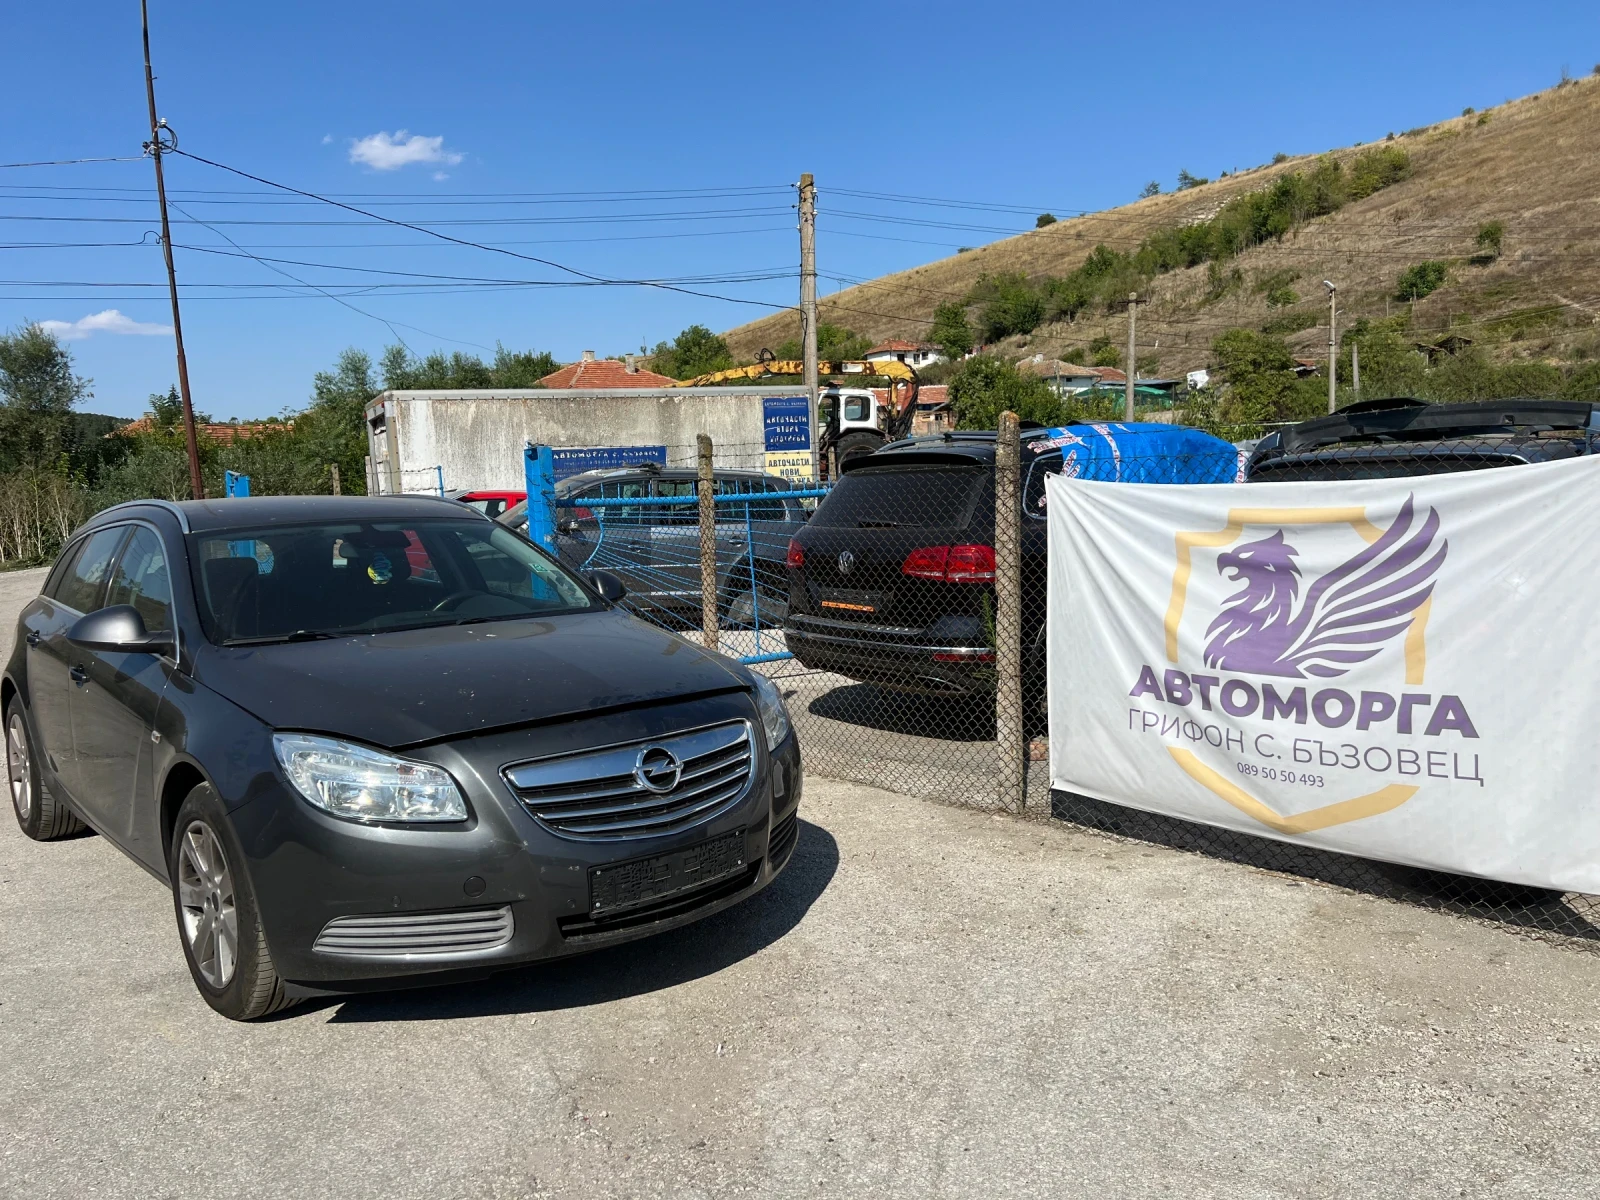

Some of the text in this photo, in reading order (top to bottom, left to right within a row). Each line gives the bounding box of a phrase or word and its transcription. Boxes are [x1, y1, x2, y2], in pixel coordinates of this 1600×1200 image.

[768, 458, 810, 467] АВТОЧАСТИ
[779, 467, 800, 477] НОВИ
[1129, 664, 1481, 739] АВТОМОРГА
[1129, 708, 1484, 787] ГРИФОН С. БЪЗОВЕЦ
[1237, 762, 1325, 788] 089 50 50 493
